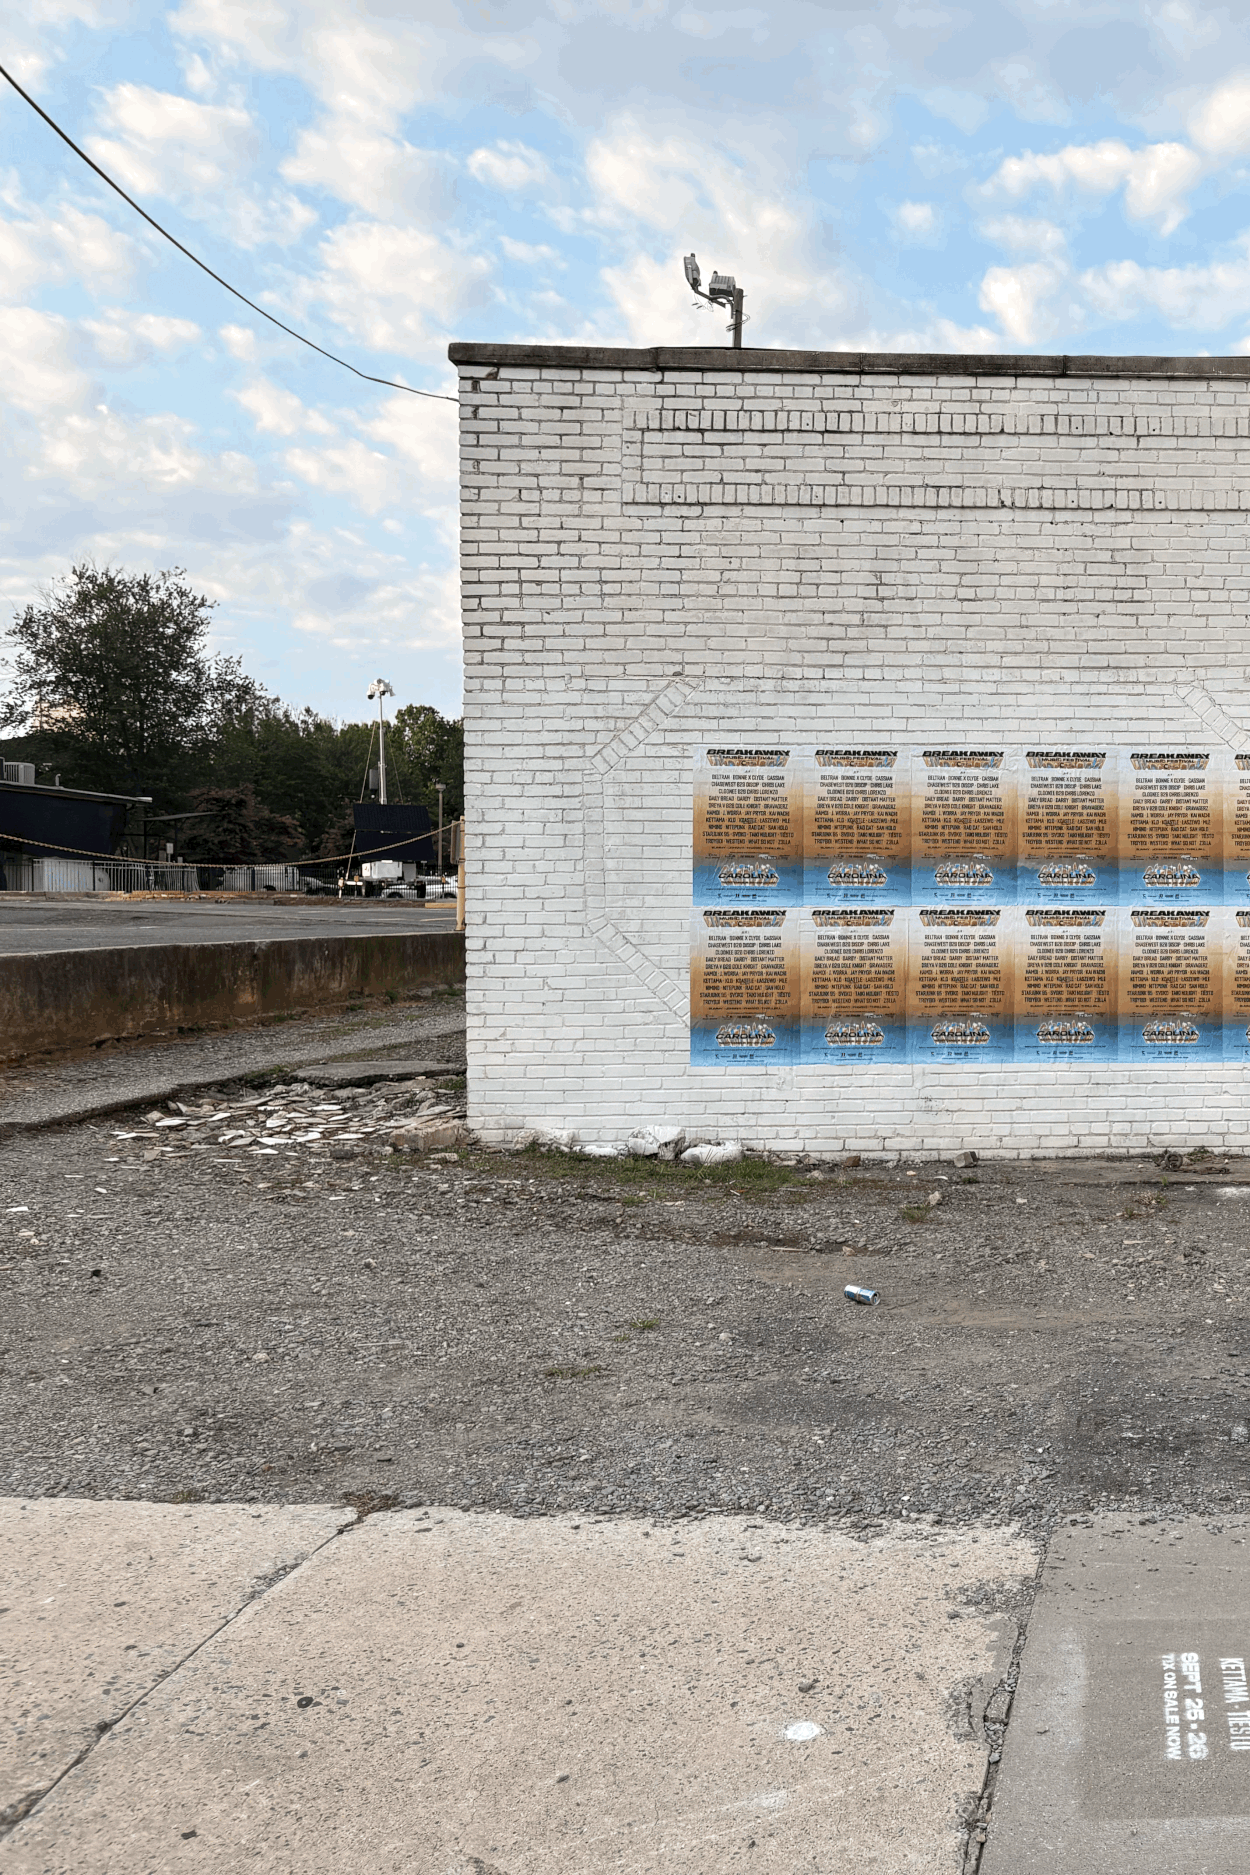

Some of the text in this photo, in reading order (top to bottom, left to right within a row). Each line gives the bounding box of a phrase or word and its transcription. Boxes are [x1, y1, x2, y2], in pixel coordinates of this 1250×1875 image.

[1163, 1672, 1176, 1688] ON
[1219, 1657, 1249, 1704] KETTAMA
[1164, 1691, 1179, 1724] SALE
[1181, 1652, 1209, 1760] SEPT 25 26
[1166, 1726, 1181, 1760] NOW
